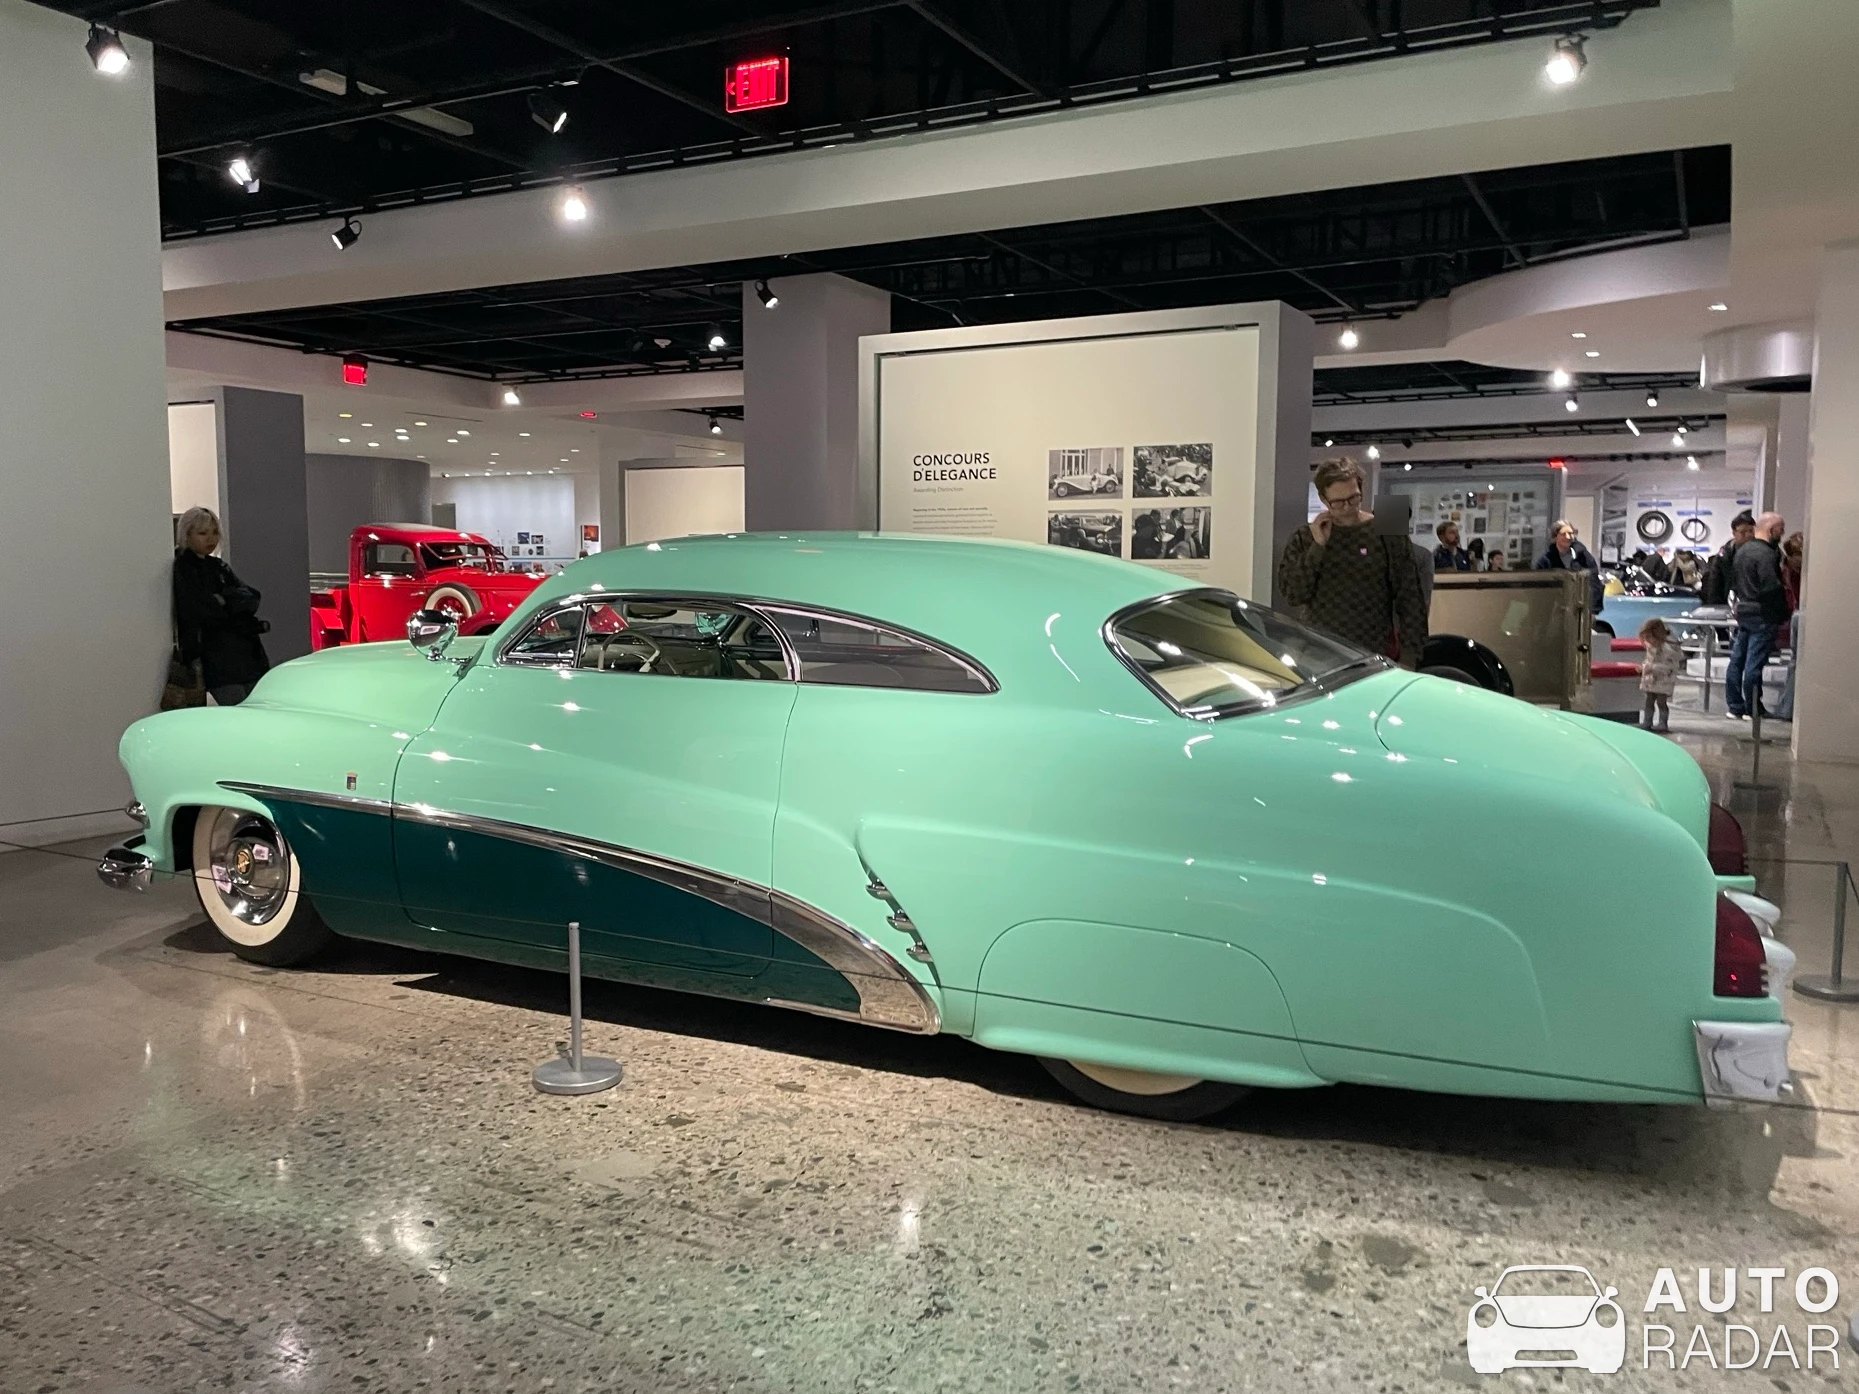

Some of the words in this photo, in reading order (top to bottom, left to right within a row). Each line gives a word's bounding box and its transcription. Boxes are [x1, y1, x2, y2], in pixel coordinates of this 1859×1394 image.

[736, 60, 780, 107] EXIT
[913, 452, 990, 467] CONCOURS
[913, 468, 997, 481] D'ELEGANCE
